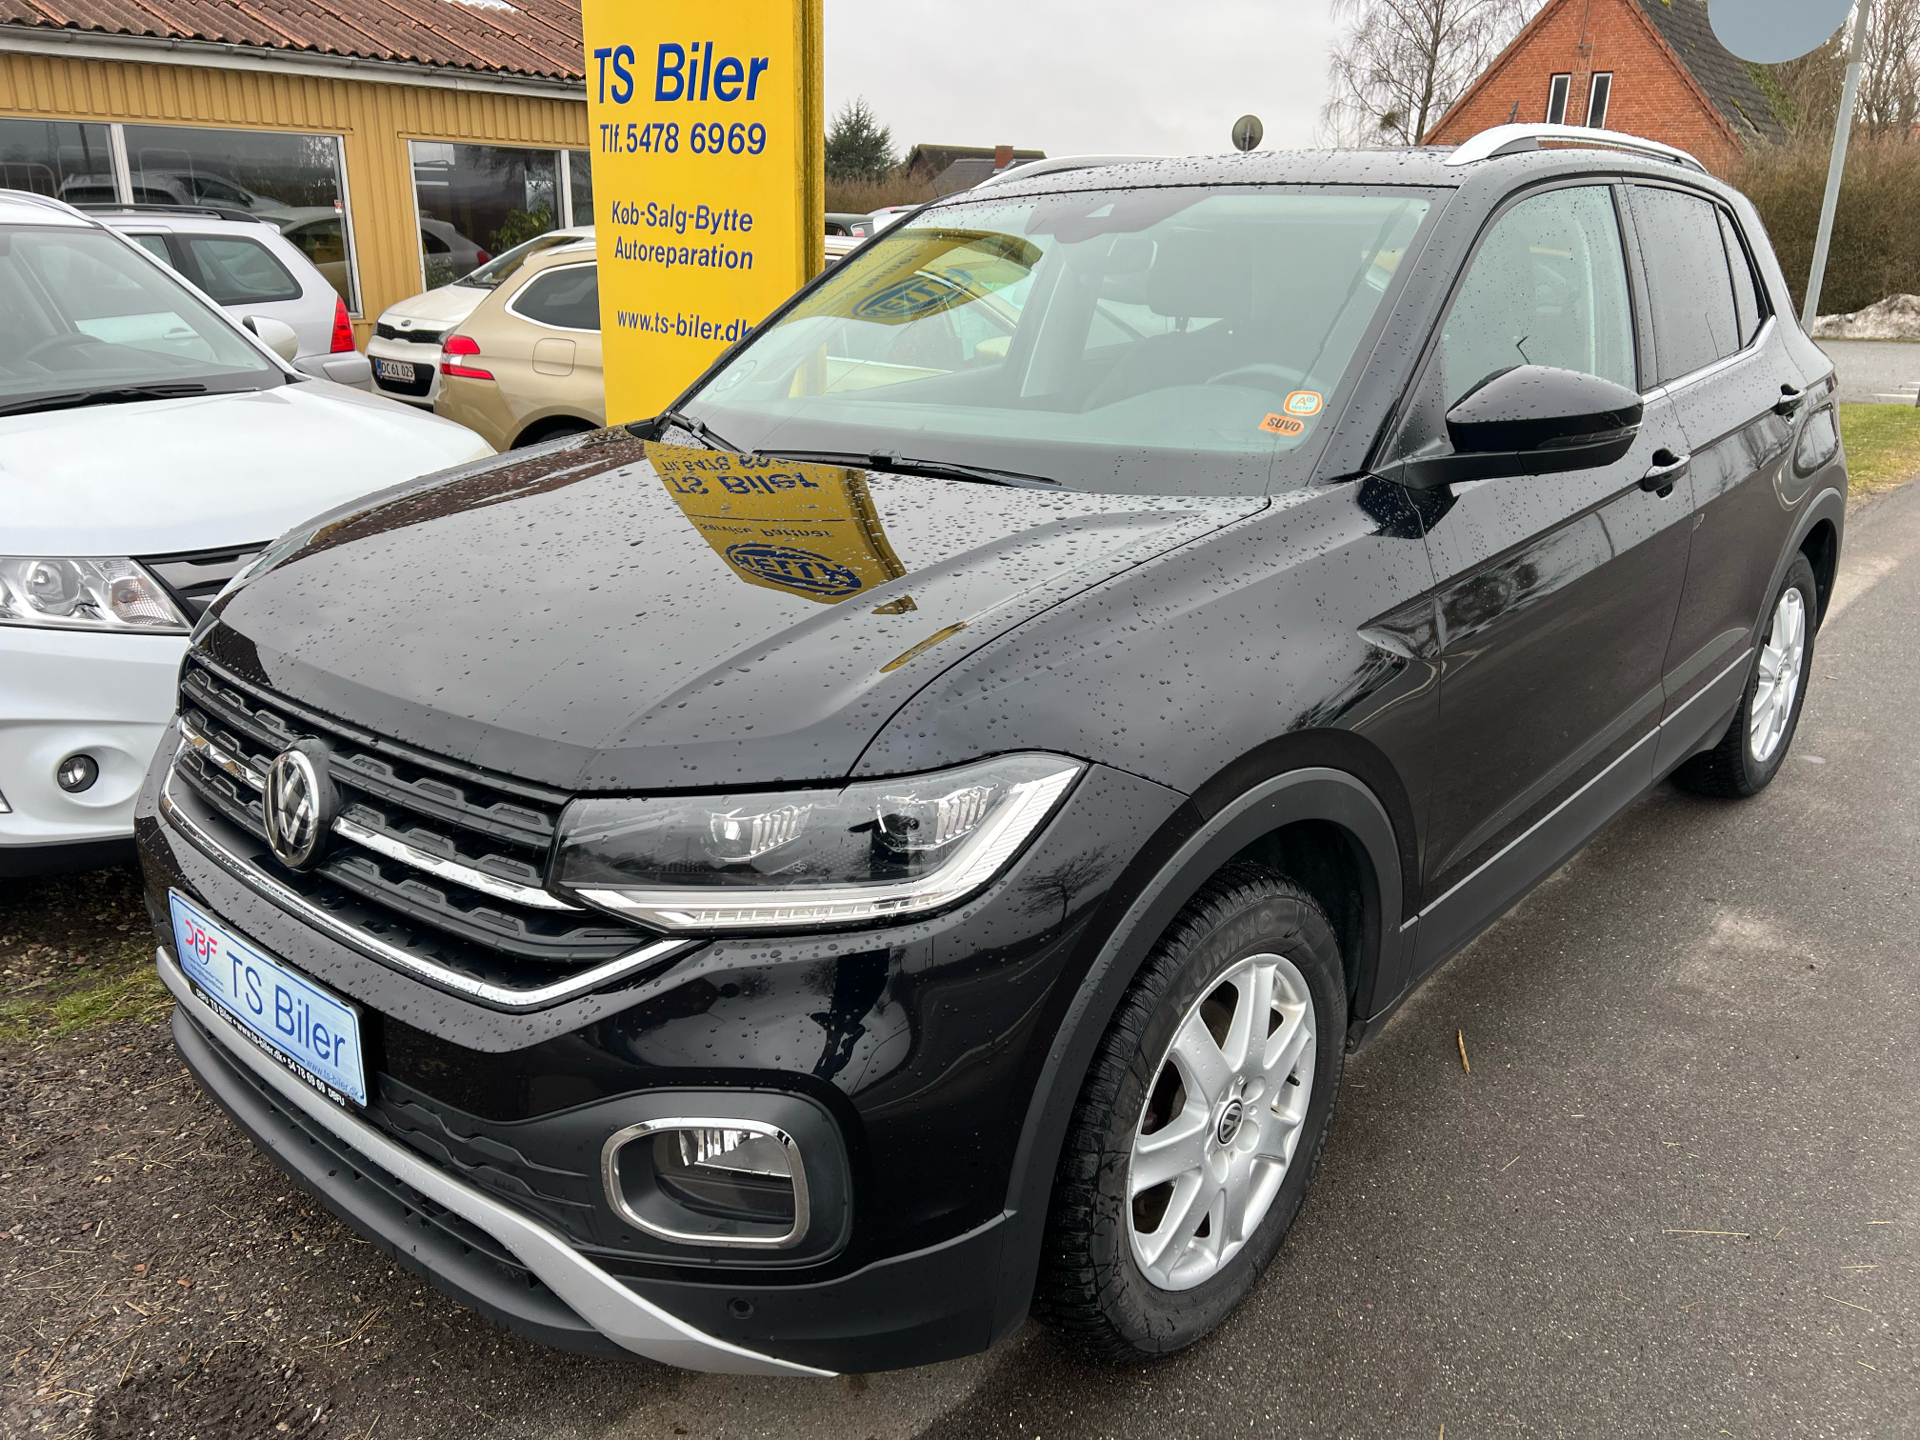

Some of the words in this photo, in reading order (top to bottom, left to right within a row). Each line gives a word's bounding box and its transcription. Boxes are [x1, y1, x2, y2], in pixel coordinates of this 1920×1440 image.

[594, 45, 635, 104] TS
[655, 41, 769, 102] Biler
[690, 122, 767, 155] 6969
[611, 200, 753, 235] Køb-Salg-Bytte
[614, 236, 754, 270] Autoreparation
[1267, 417, 1301, 432] SUVO
[226, 950, 263, 1015] TS
[275, 984, 346, 1067] Biler
